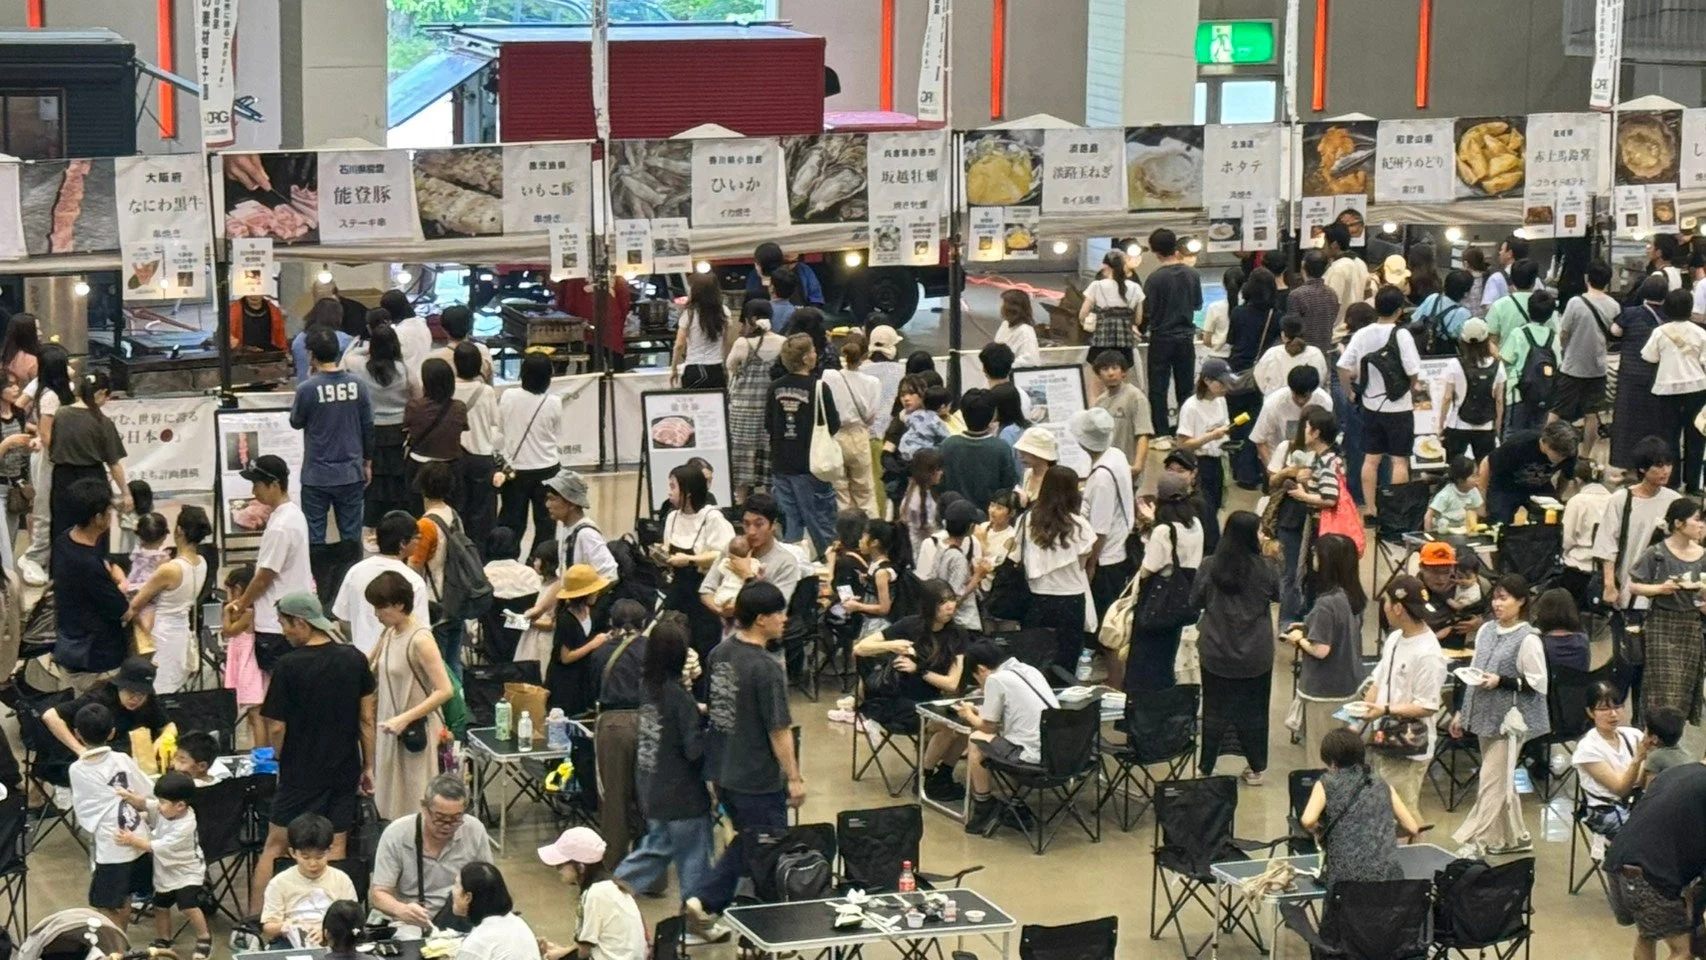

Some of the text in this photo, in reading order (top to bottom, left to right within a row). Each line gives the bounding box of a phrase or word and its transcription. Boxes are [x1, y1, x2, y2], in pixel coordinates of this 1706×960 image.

[1221, 160, 1262, 174] ホタテ
[1382, 156, 1444, 170] 紀州うめどり
[145, 172, 183, 184] 大阪府
[881, 168, 939, 184] 坂越牡蠣
[1052, 164, 1114, 179] 淡路玉ねぎ
[521, 181, 575, 197] いもこ豚
[711, 176, 761, 193] ひいか
[333, 185, 392, 205] 能登豚
[128, 195, 205, 215] なにわ黒牛
[316, 382, 359, 403] 1969
